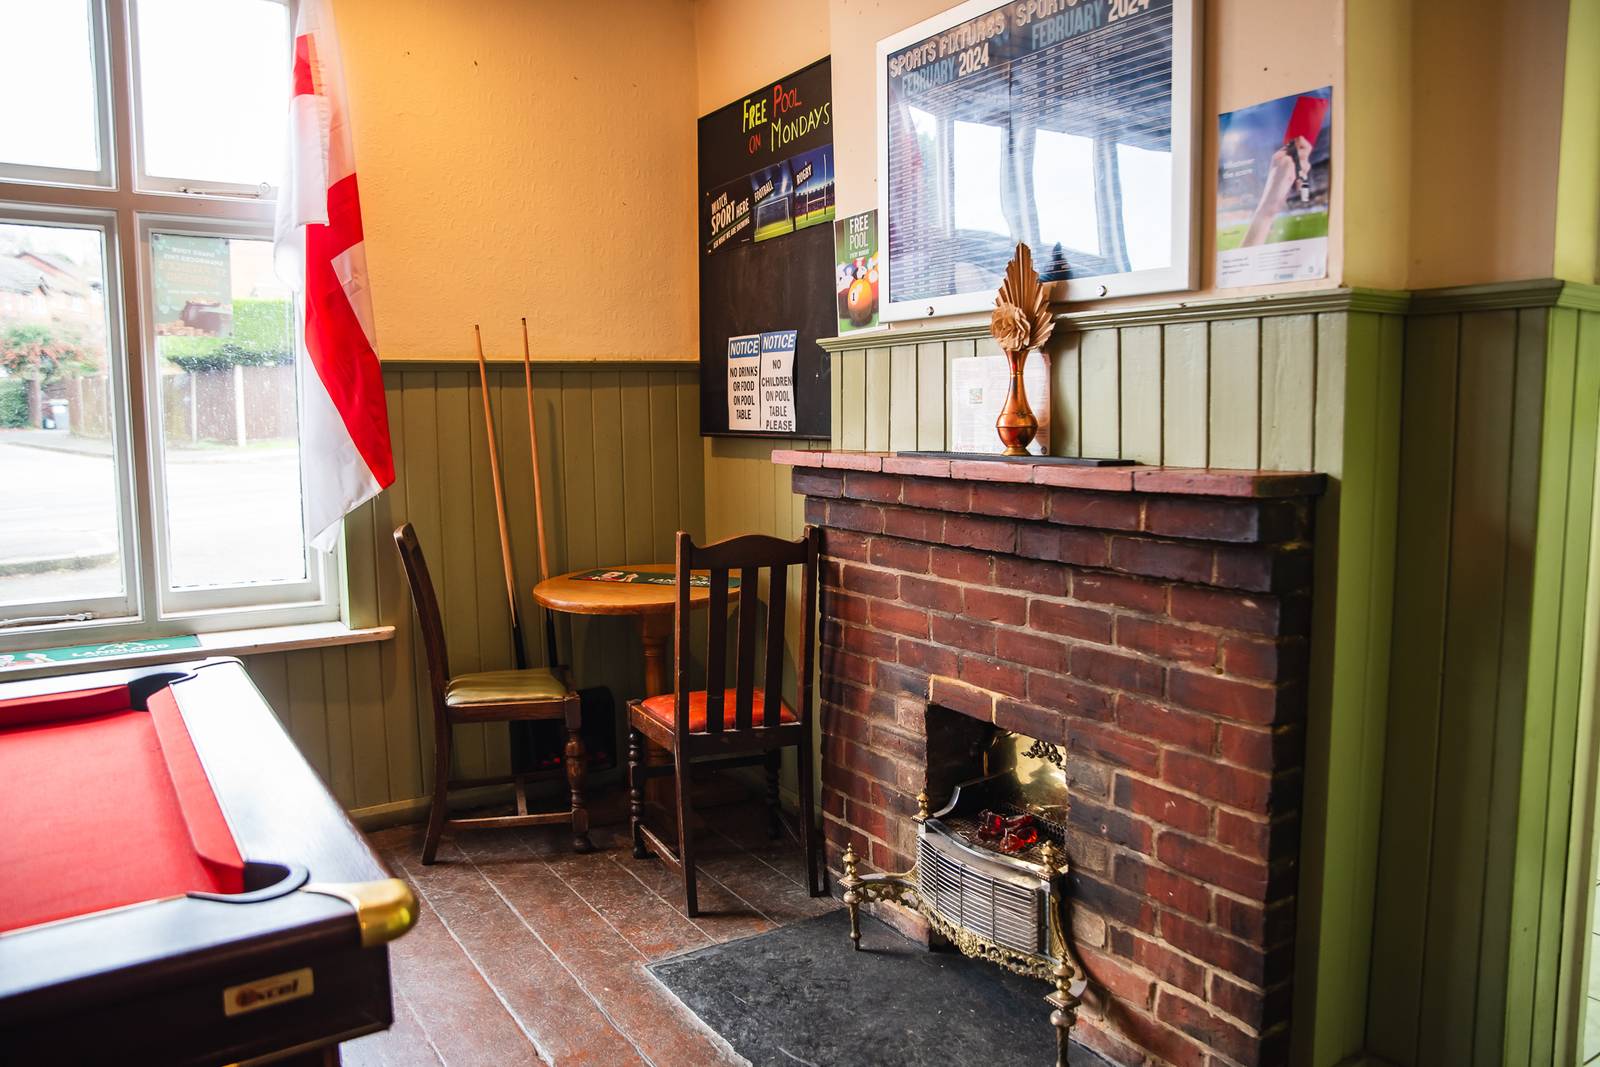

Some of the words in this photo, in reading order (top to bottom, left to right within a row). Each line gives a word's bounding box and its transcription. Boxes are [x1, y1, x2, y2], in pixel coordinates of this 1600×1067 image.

[1016, 0, 1077, 27] SPOR
[1031, 1, 1104, 51] FEBRUARY
[889, 40, 937, 78] SPORTS
[940, 12, 1005, 58] FIXTURES
[902, 55, 956, 98] FEBRUARY
[958, 42, 990, 77] 2024
[743, 99, 768, 133] FREE
[774, 84, 802, 118] POOL
[749, 133, 761, 154] ON
[771, 102, 830, 152] MONDAYS
[796, 164, 812, 186] RUGBY
[754, 179, 774, 203] FOOTBALL
[711, 200, 736, 236] SPORT
[736, 197, 750, 219] HERE
[849, 214, 869, 234] FREE
[849, 231, 869, 250] POOL
[730, 340, 759, 356] NOTICE
[763, 334, 795, 350] NOTICE
[730, 367, 738, 378] NO
[739, 366, 758, 378] DRINKS
[772, 360, 781, 370] NO
[733, 381, 740, 391] OR
[741, 381, 754, 391] FOOD
[762, 376, 793, 387] CHILDREN
[733, 395, 740, 405] ON
[741, 395, 755, 405] POOL
[766, 391, 774, 402] ON
[775, 390, 790, 402] POOL
[736, 409, 751, 420] TABLE
[769, 406, 787, 417] TABLE
[766, 420, 792, 431] PLEASE
